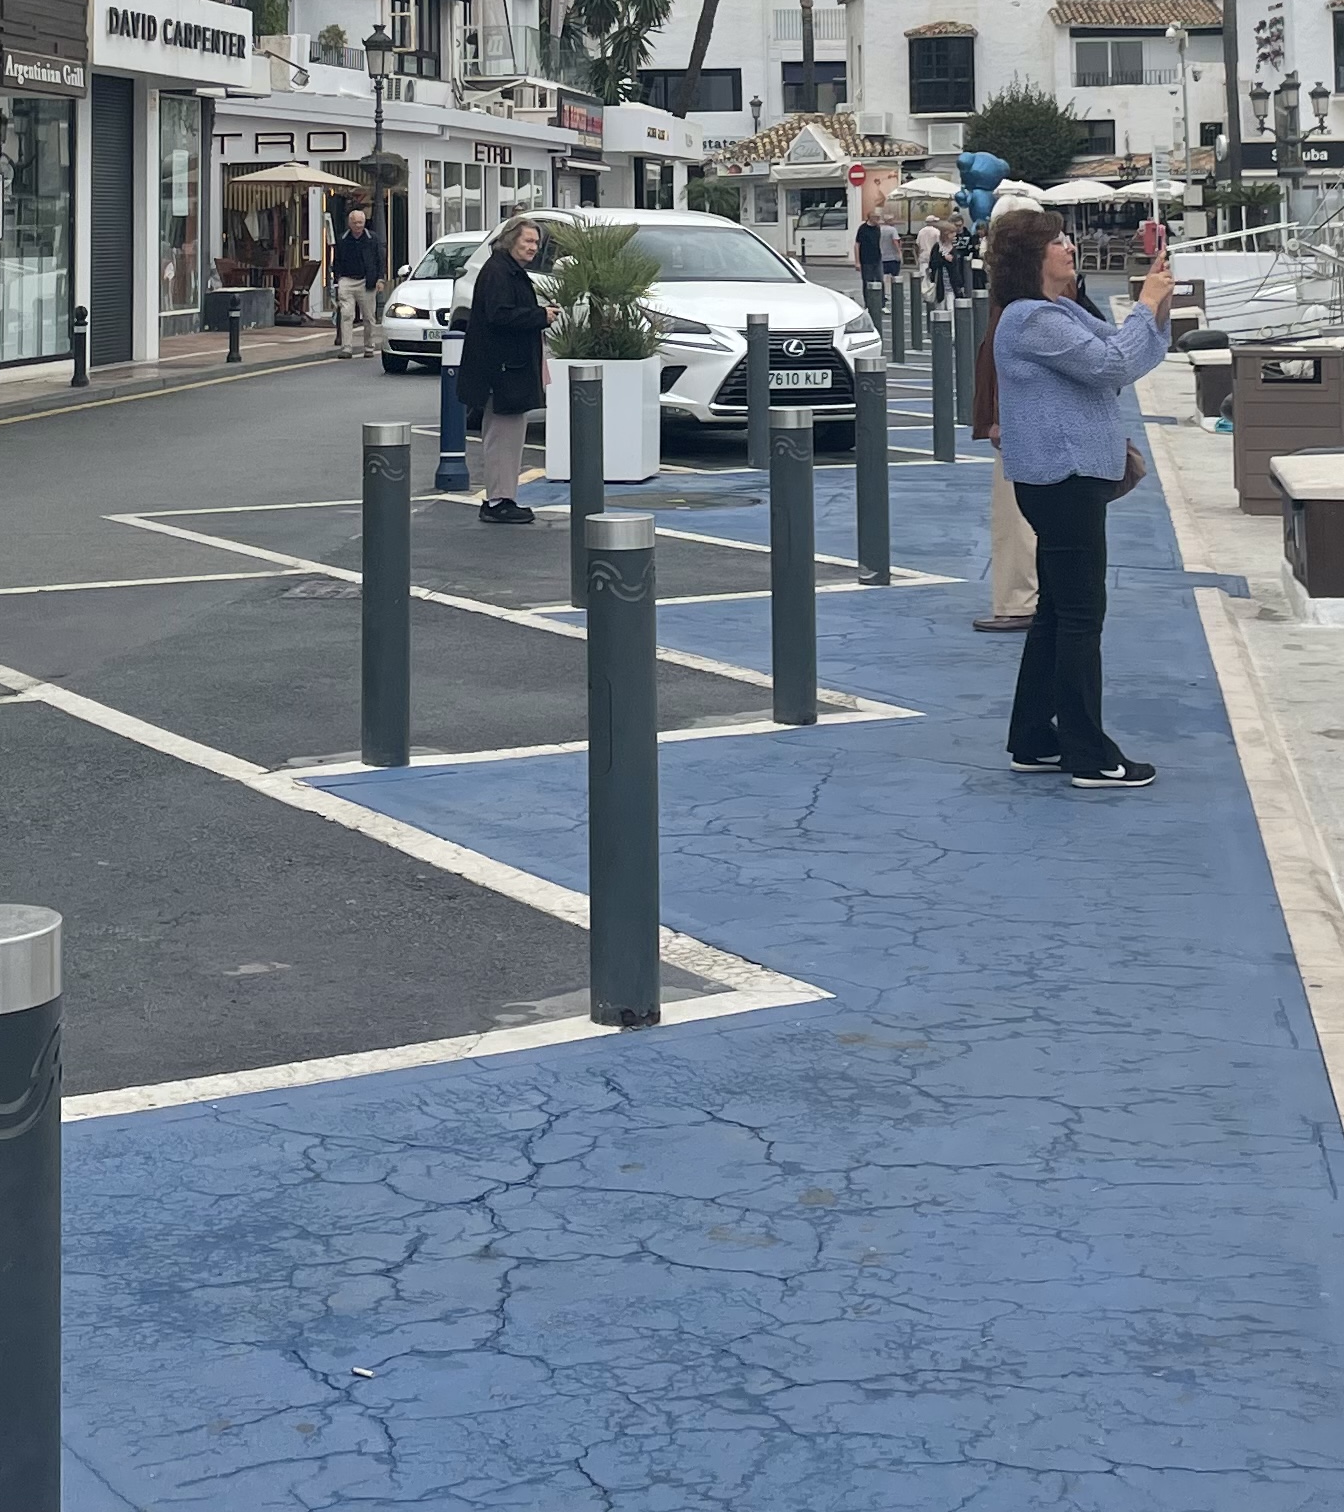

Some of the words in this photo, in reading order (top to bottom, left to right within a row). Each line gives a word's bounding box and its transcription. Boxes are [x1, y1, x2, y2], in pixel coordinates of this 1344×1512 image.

[108, 6, 158, 42] DAVID
[163, 18, 247, 59] CARPENTER
[5, 54, 62, 85] Argentinian
[62, 64, 86, 88] Grill
[213, 132, 348, 155] TRO
[474, 141, 513, 165] ETRO
[702, 139, 737, 149] state
[769, 372, 799, 386] 7610
[805, 372, 828, 385] KLP
